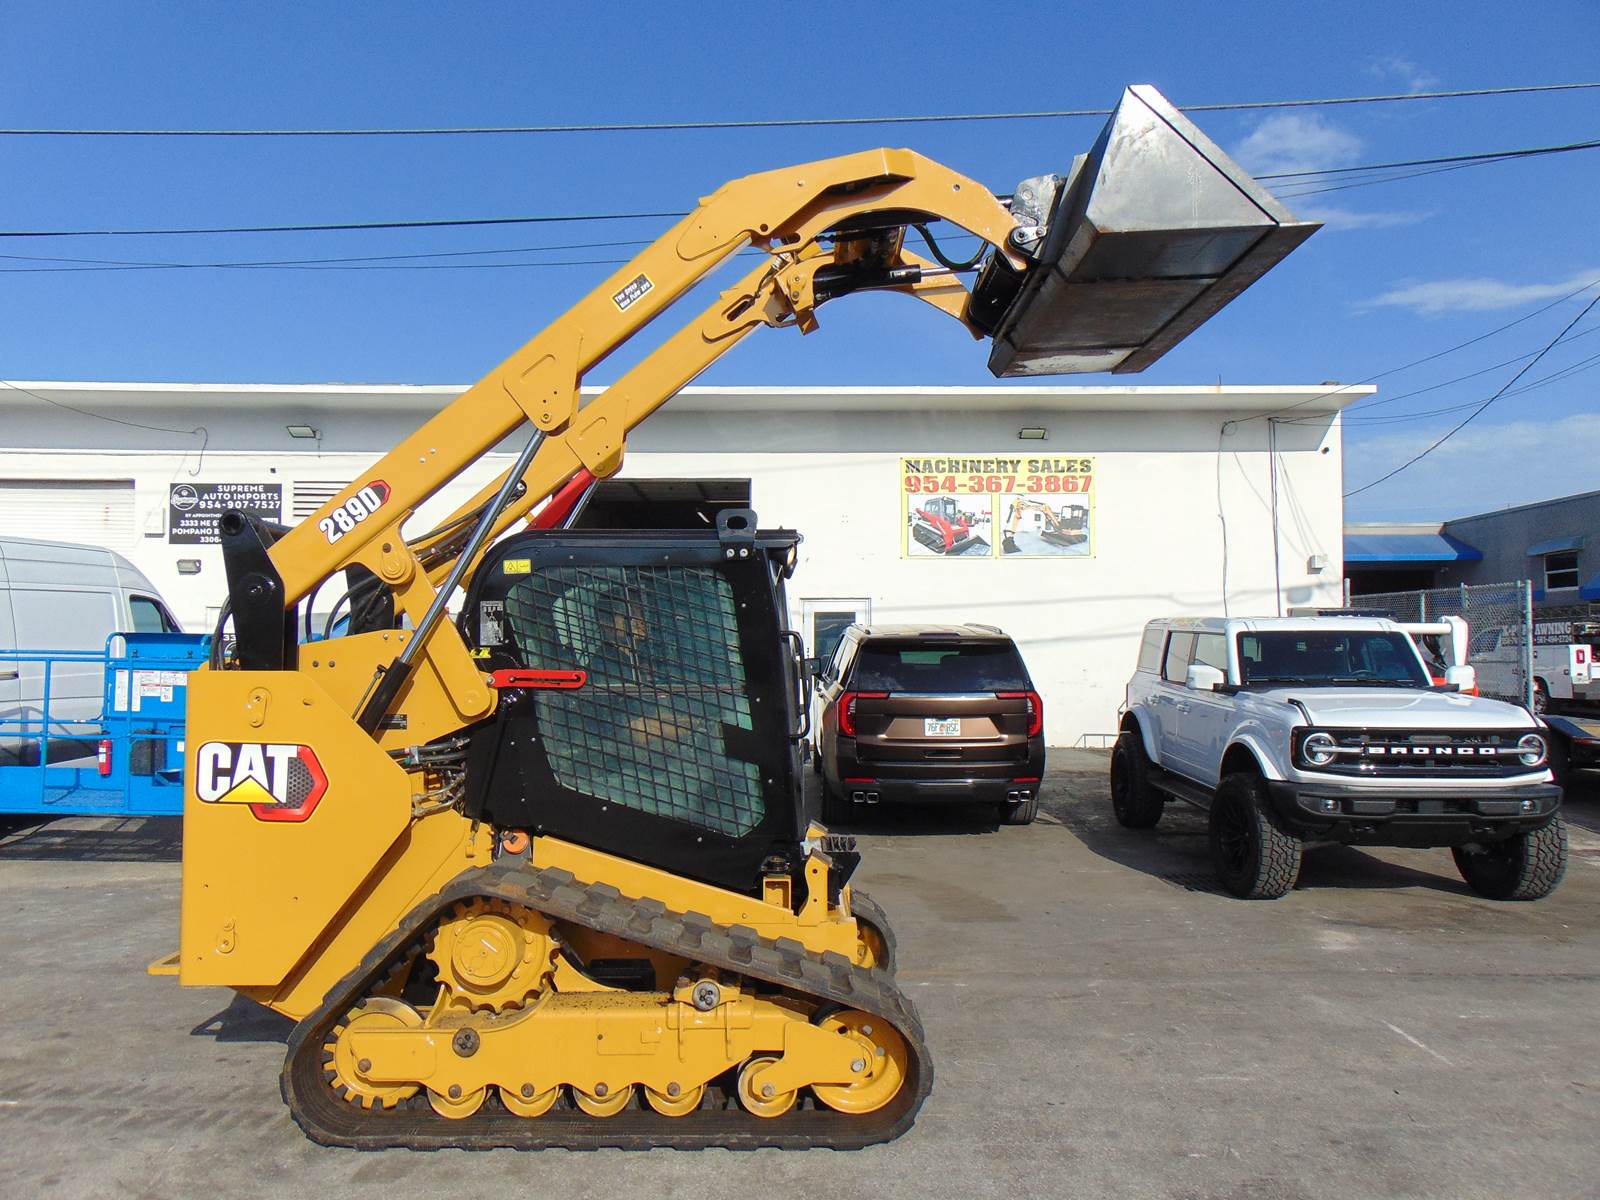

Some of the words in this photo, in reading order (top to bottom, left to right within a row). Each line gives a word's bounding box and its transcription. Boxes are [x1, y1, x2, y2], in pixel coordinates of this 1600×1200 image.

[905, 459, 1021, 474] MACHINERY
[1027, 459, 1092, 474] SALES
[904, 475, 1092, 493] 954-367-3867
[199, 501, 281, 509] 954-907-7527
[320, 486, 382, 545] 289D
[1535, 622, 1571, 635] AWNING
[1368, 747, 1496, 755] BRONCO
[198, 742, 297, 804] CAT
